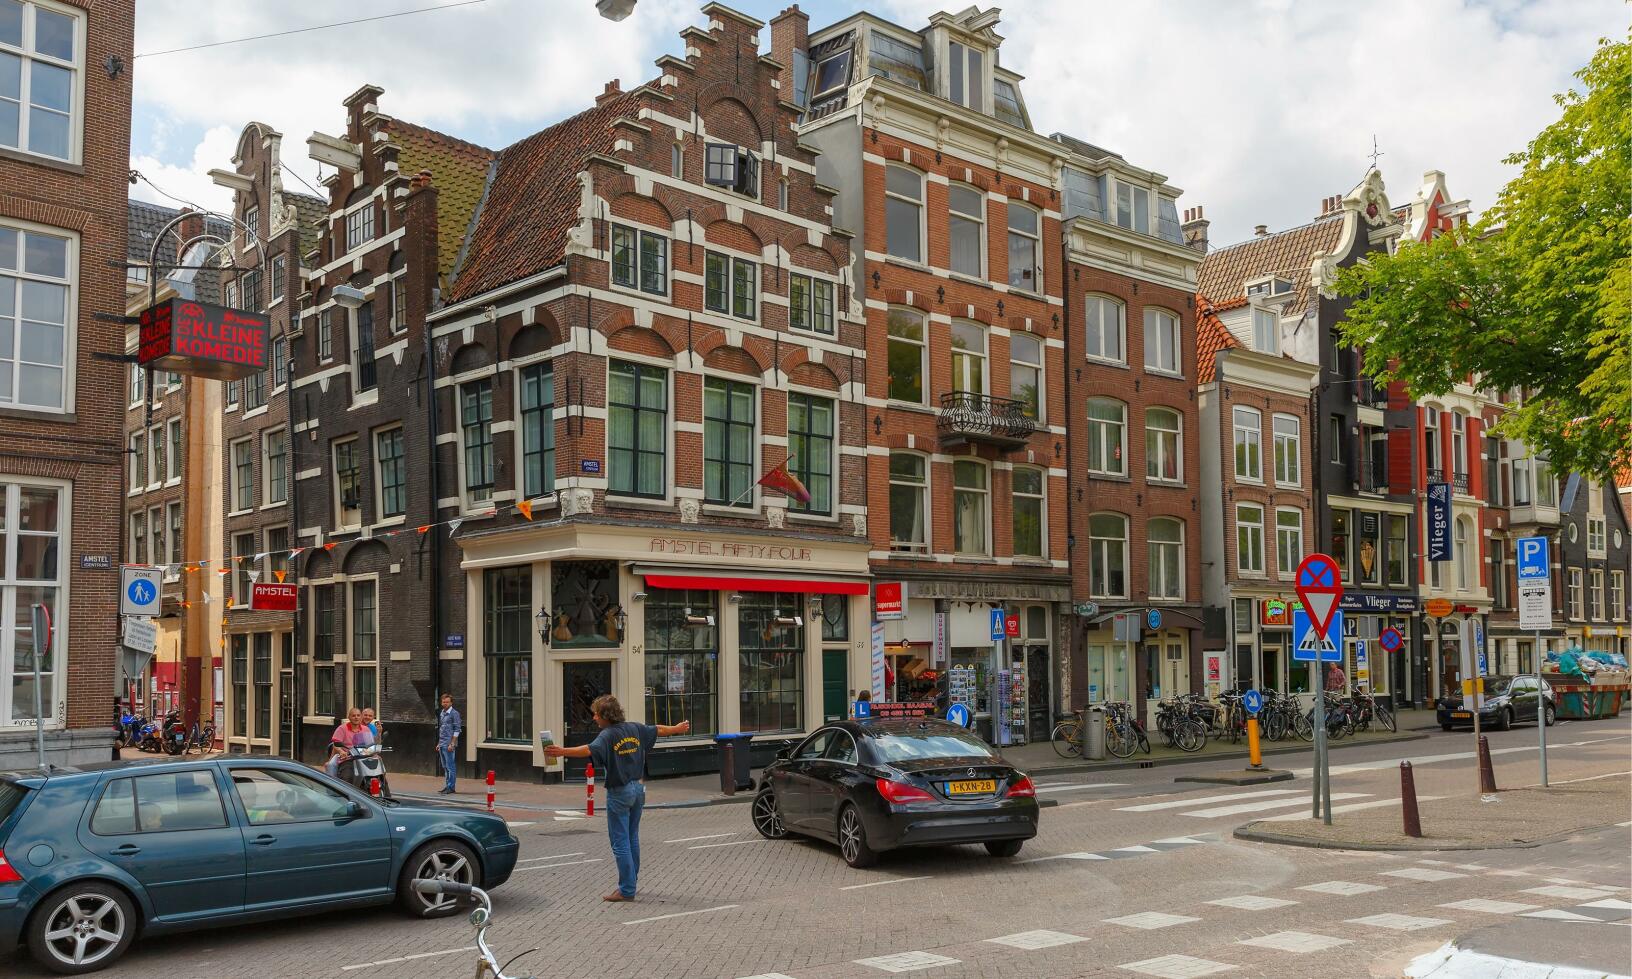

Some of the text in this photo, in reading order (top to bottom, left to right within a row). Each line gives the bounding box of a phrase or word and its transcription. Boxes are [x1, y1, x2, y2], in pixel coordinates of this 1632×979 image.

[193, 319, 265, 348] KLEINE
[176, 336, 265, 366] KOMEDIE
[1431, 505, 1447, 559] Vlieger
[650, 538, 812, 561] AMSTEL FIFTY FOUR
[1523, 541, 1541, 562] P
[83, 555, 109, 563] AMSTEL
[255, 586, 296, 597] AMSTEL
[877, 600, 902, 610] supermarkt
[1365, 595, 1391, 609] Vlieger
[1357, 642, 1364, 653] P
[859, 703, 867, 715] L
[952, 781, 992, 792] 1-KXN-28
